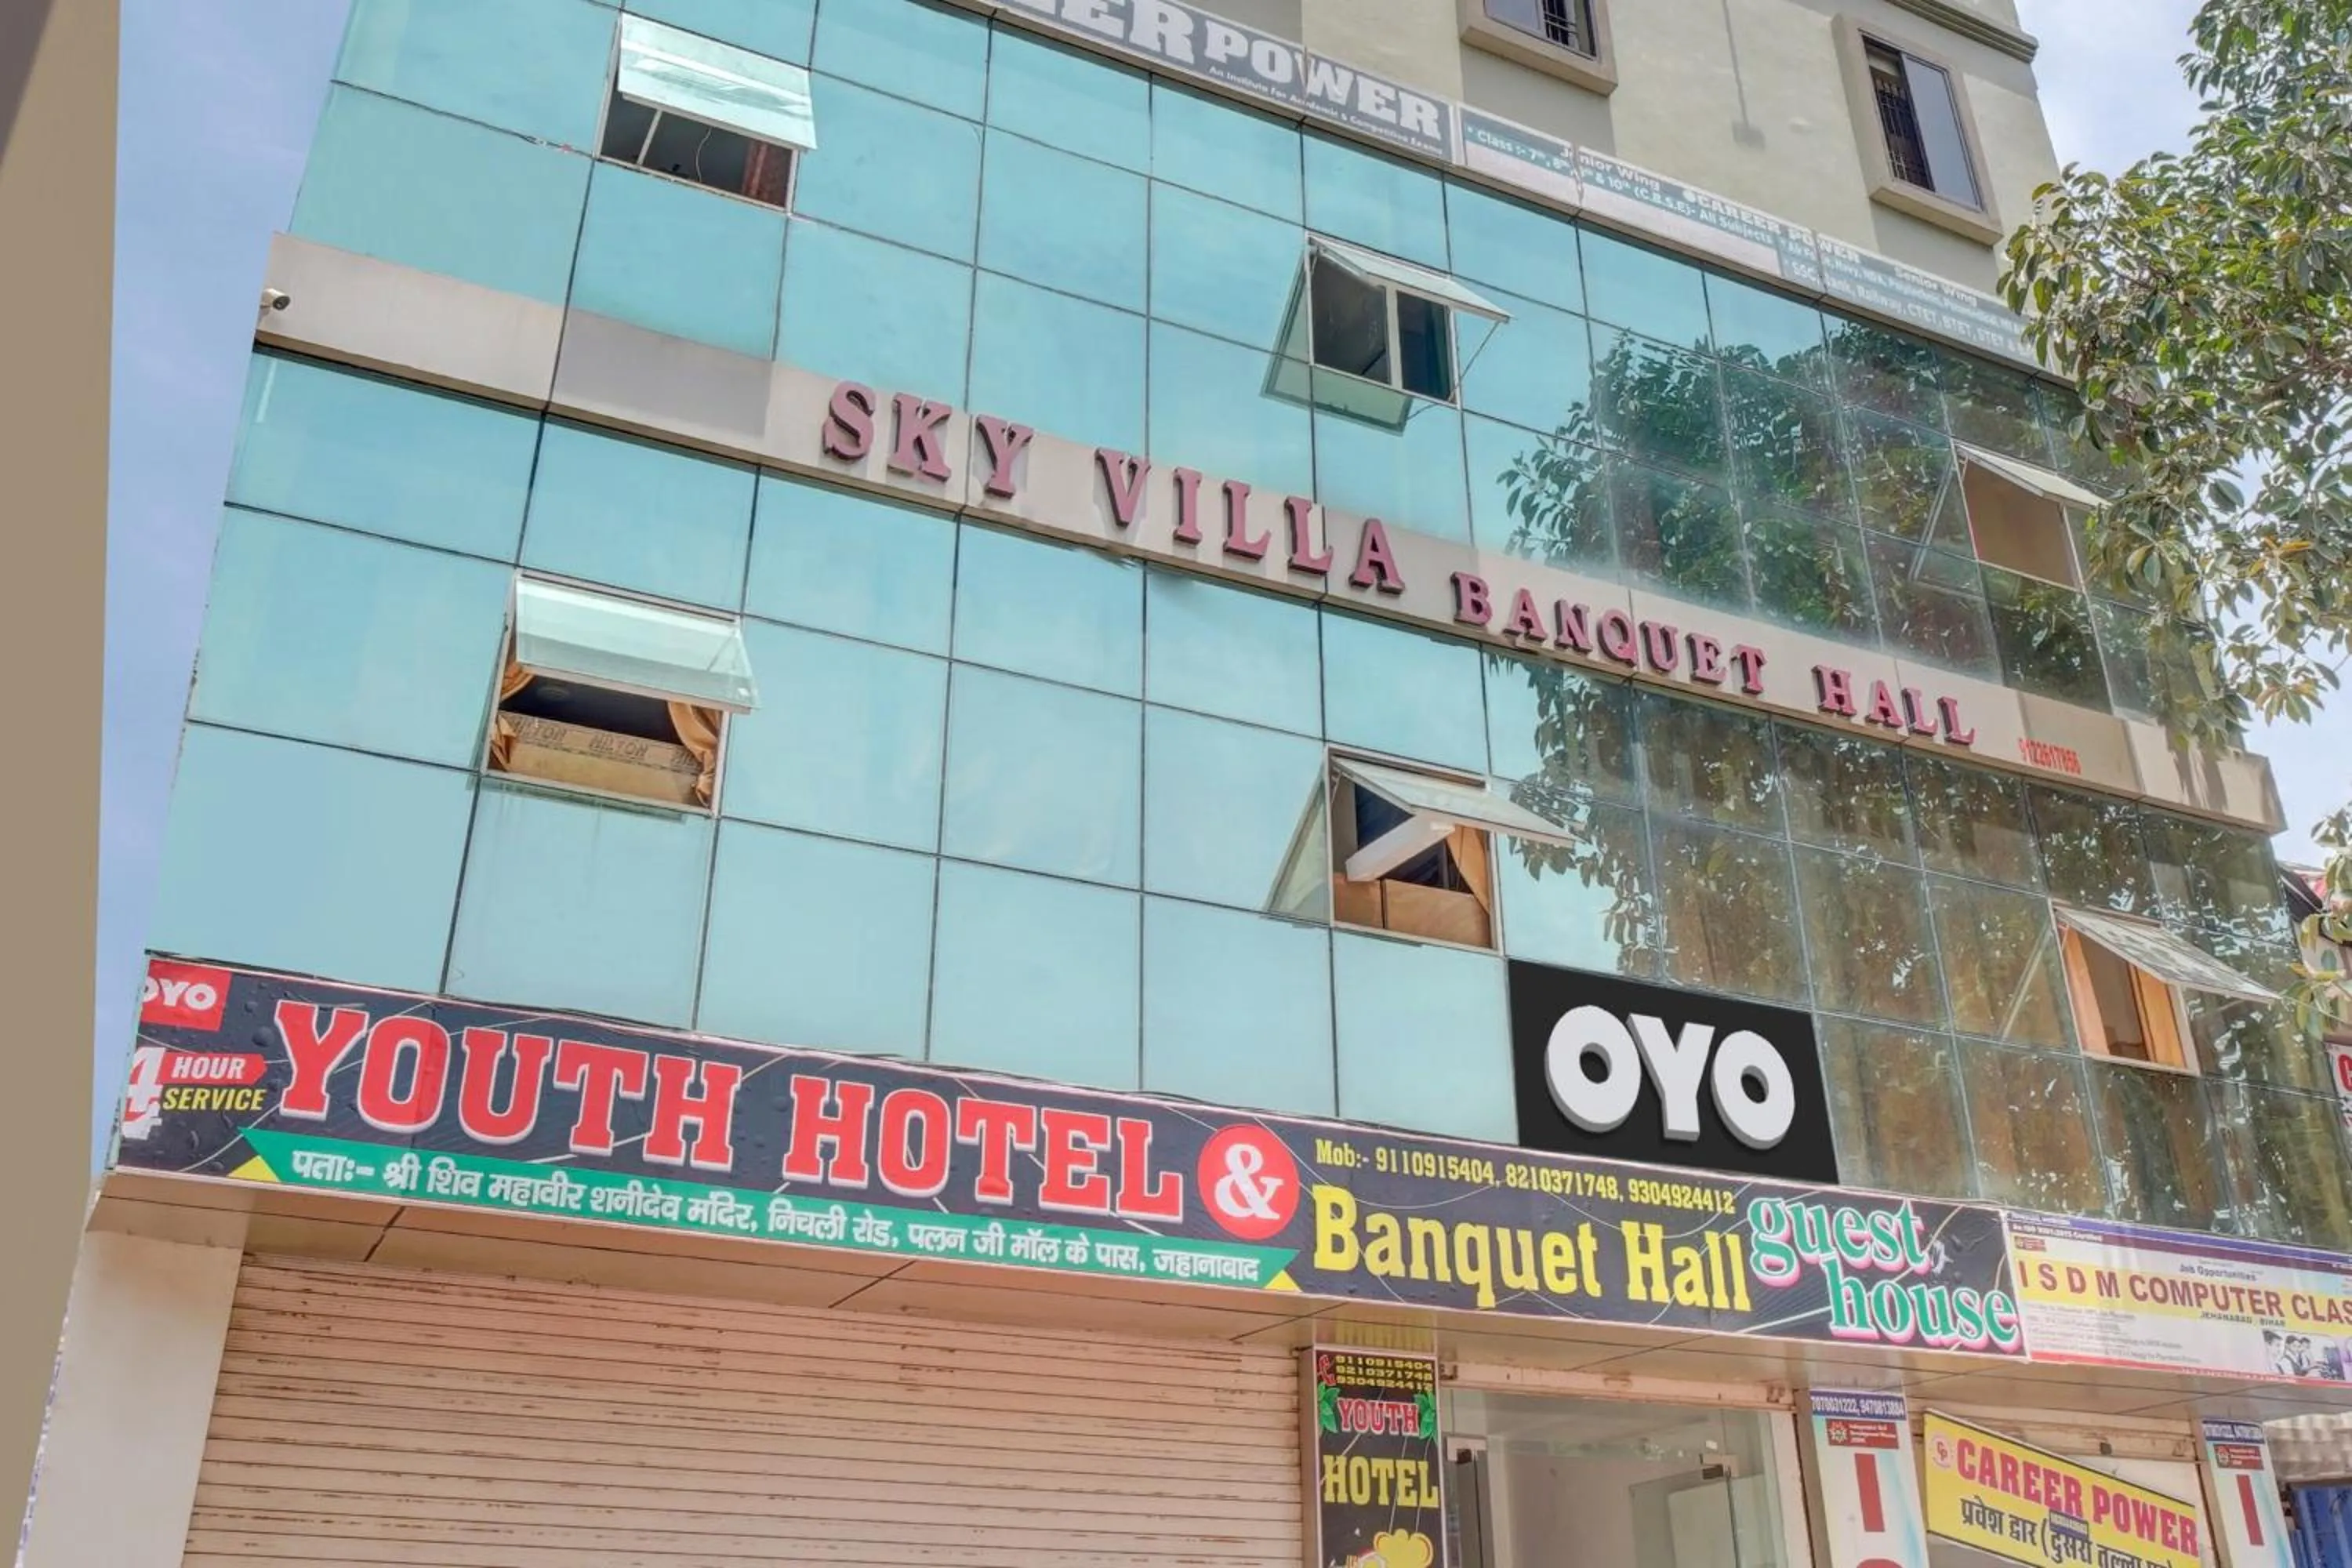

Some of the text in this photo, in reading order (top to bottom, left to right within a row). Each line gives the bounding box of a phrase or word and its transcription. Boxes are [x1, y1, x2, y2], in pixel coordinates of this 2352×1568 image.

[1204, 20, 1441, 140] POWER
[1476, 130, 1512, 151] Class
[1617, 165, 1661, 192] Wing
[823, 380, 1976, 746] SKY VILLA BANQUET HALL
[162, 1087, 268, 1112] SERVICE
[170, 1056, 246, 1080] HOUR
[1544, 1004, 1795, 1151] OYO
[275, 999, 1284, 1223] YOUTH HOTEL &
[383, 1152, 423, 1191] श्री
[426, 1156, 485, 1198] शिव
[488, 1170, 587, 1211] महावीर
[768, 1197, 848, 1240] निचली
[852, 1209, 899, 1249] रोड,
[972, 1221, 1007, 1256] जी
[1010, 1228, 1062, 1264] मॉल
[1065, 1232, 1091, 1265] के
[1094, 1242, 1147, 1273] पास,
[1152, 1248, 1261, 1282] जहानाबाद
[1627, 1178, 1737, 1214] 9304924412
[1312, 1184, 1753, 1312] Banquet Hall
[1747, 1196, 1932, 1287] guest
[1820, 1254, 2025, 1354] house
[2017, 1261, 2029, 1288] I
[2039, 1262, 2059, 1291] S
[2066, 1265, 2086, 1294] D
[2094, 1269, 2120, 1299] M
[2129, 1275, 2286, 1319] COMPUTER
[1338, 1398, 1420, 1437] YOUTH
[1323, 1455, 1439, 1508] HOTEL
[1957, 1439, 2199, 1557] CAREER POWER
[1961, 1494, 2004, 1535] प्रवेश
[2009, 1513, 2038, 1547] द्वार
